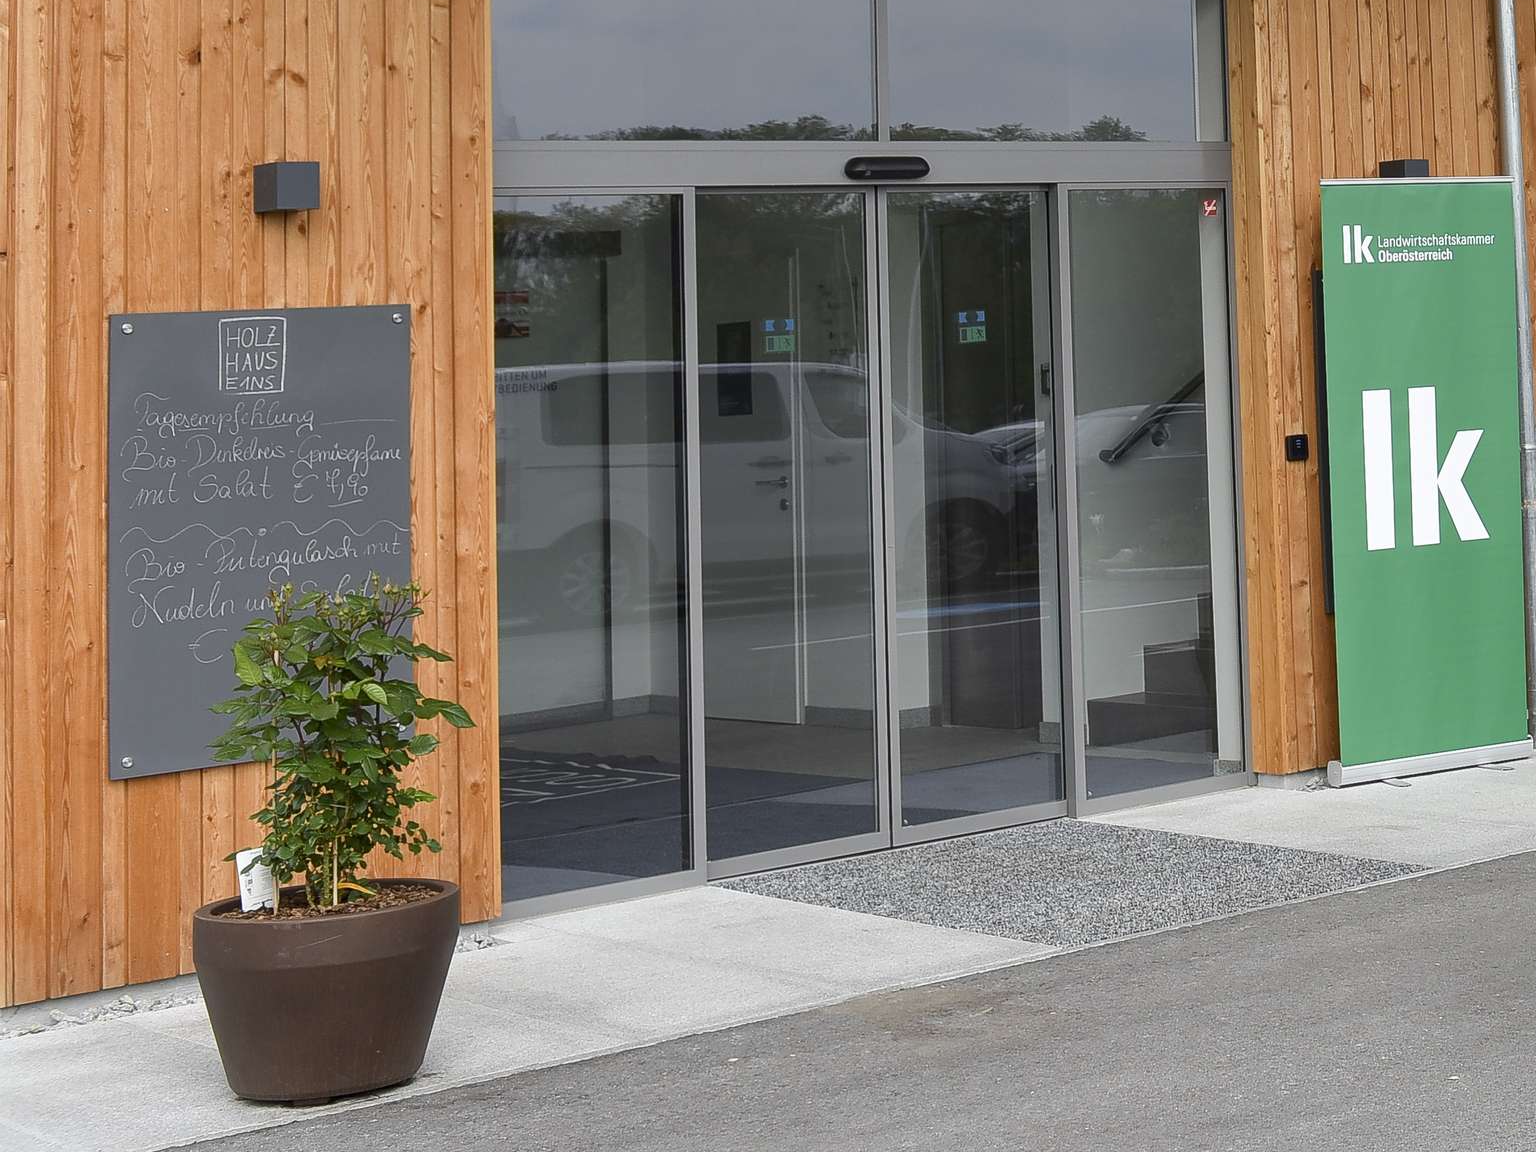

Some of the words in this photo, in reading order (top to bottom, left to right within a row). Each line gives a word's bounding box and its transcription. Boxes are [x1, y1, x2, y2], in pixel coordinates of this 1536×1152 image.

[1342, 224, 1375, 264] lk
[1377, 233, 1496, 248] Landwirtschaftskammer
[1378, 248, 1453, 263] Oberösterreich
[226, 325, 281, 348] HOLZ
[225, 351, 278, 374] HAUS
[1361, 386, 1491, 551] lk
[129, 472, 180, 509] mit
[193, 466, 274, 503] Salat
[364, 533, 401, 555] mit
[132, 581, 235, 628] Nudeln
